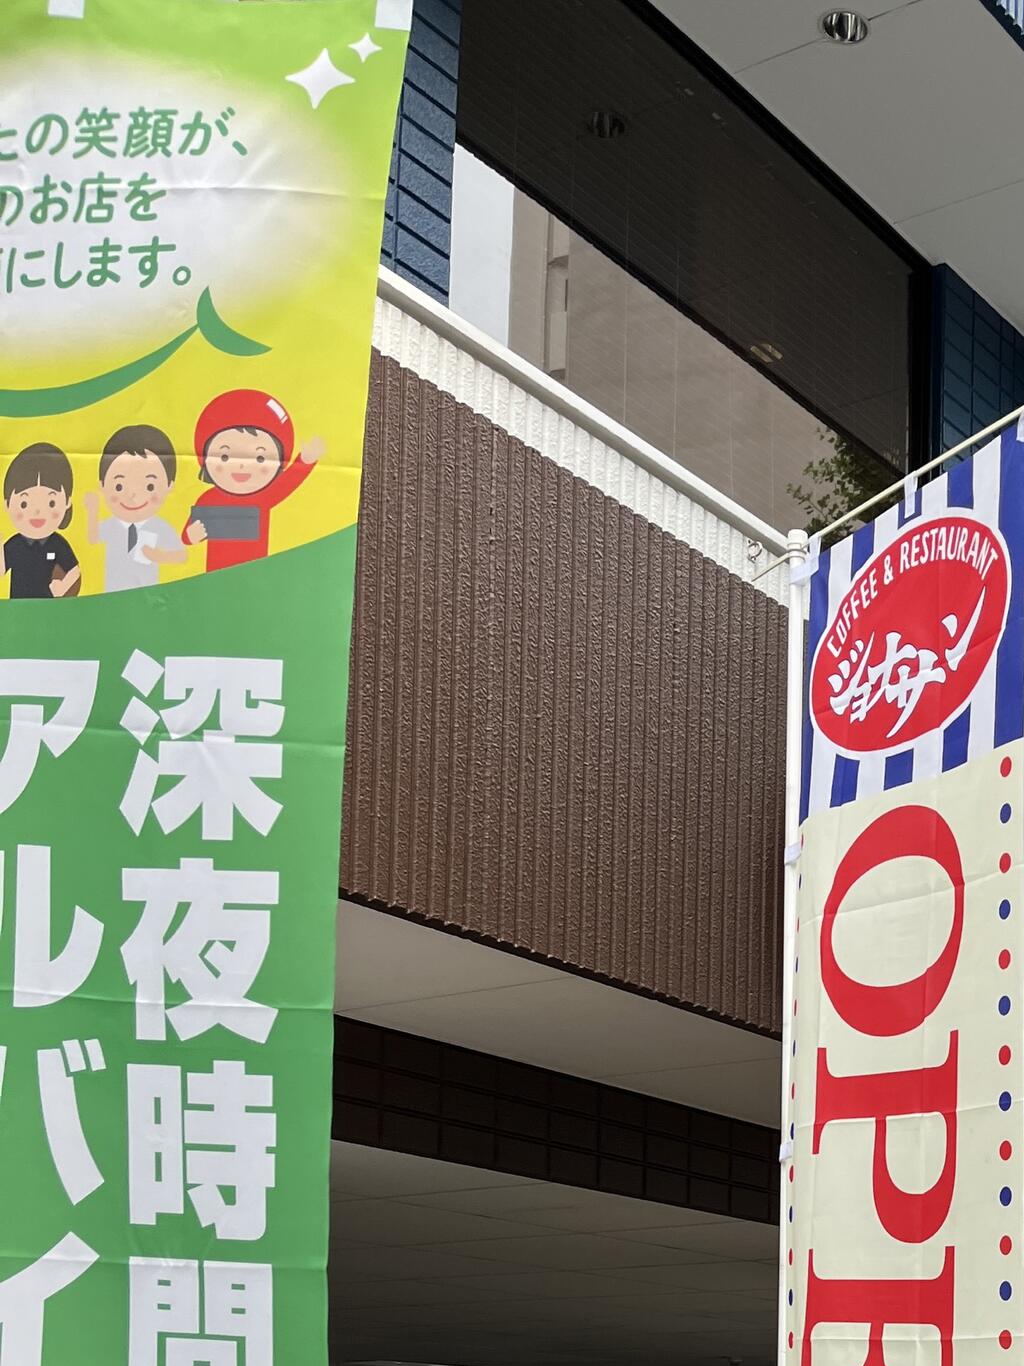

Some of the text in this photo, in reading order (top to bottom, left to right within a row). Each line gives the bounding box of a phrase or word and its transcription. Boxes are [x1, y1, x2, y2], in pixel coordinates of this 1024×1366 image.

[0, 235, 192, 293] にします。
[826, 525, 1000, 659] COFFEE & RESTAURANT
[826, 584, 987, 739] ジョナサン
